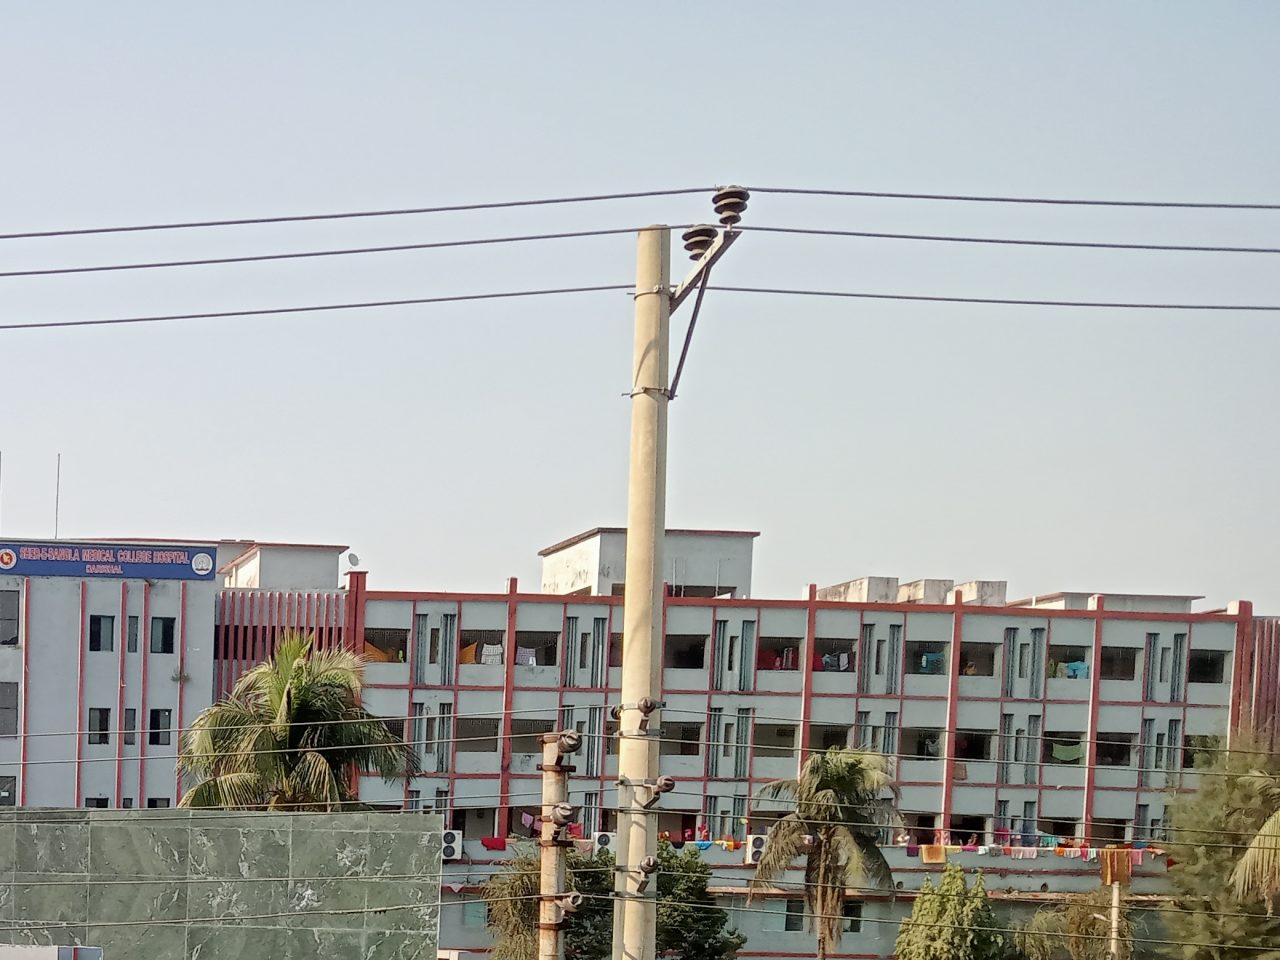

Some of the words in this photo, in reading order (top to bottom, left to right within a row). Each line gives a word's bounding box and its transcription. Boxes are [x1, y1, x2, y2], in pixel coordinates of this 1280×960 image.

[82, 549, 115, 563] MEDICAL
[117, 549, 152, 564] COLLEGE
[153, 550, 189, 564] HOSPITAL
